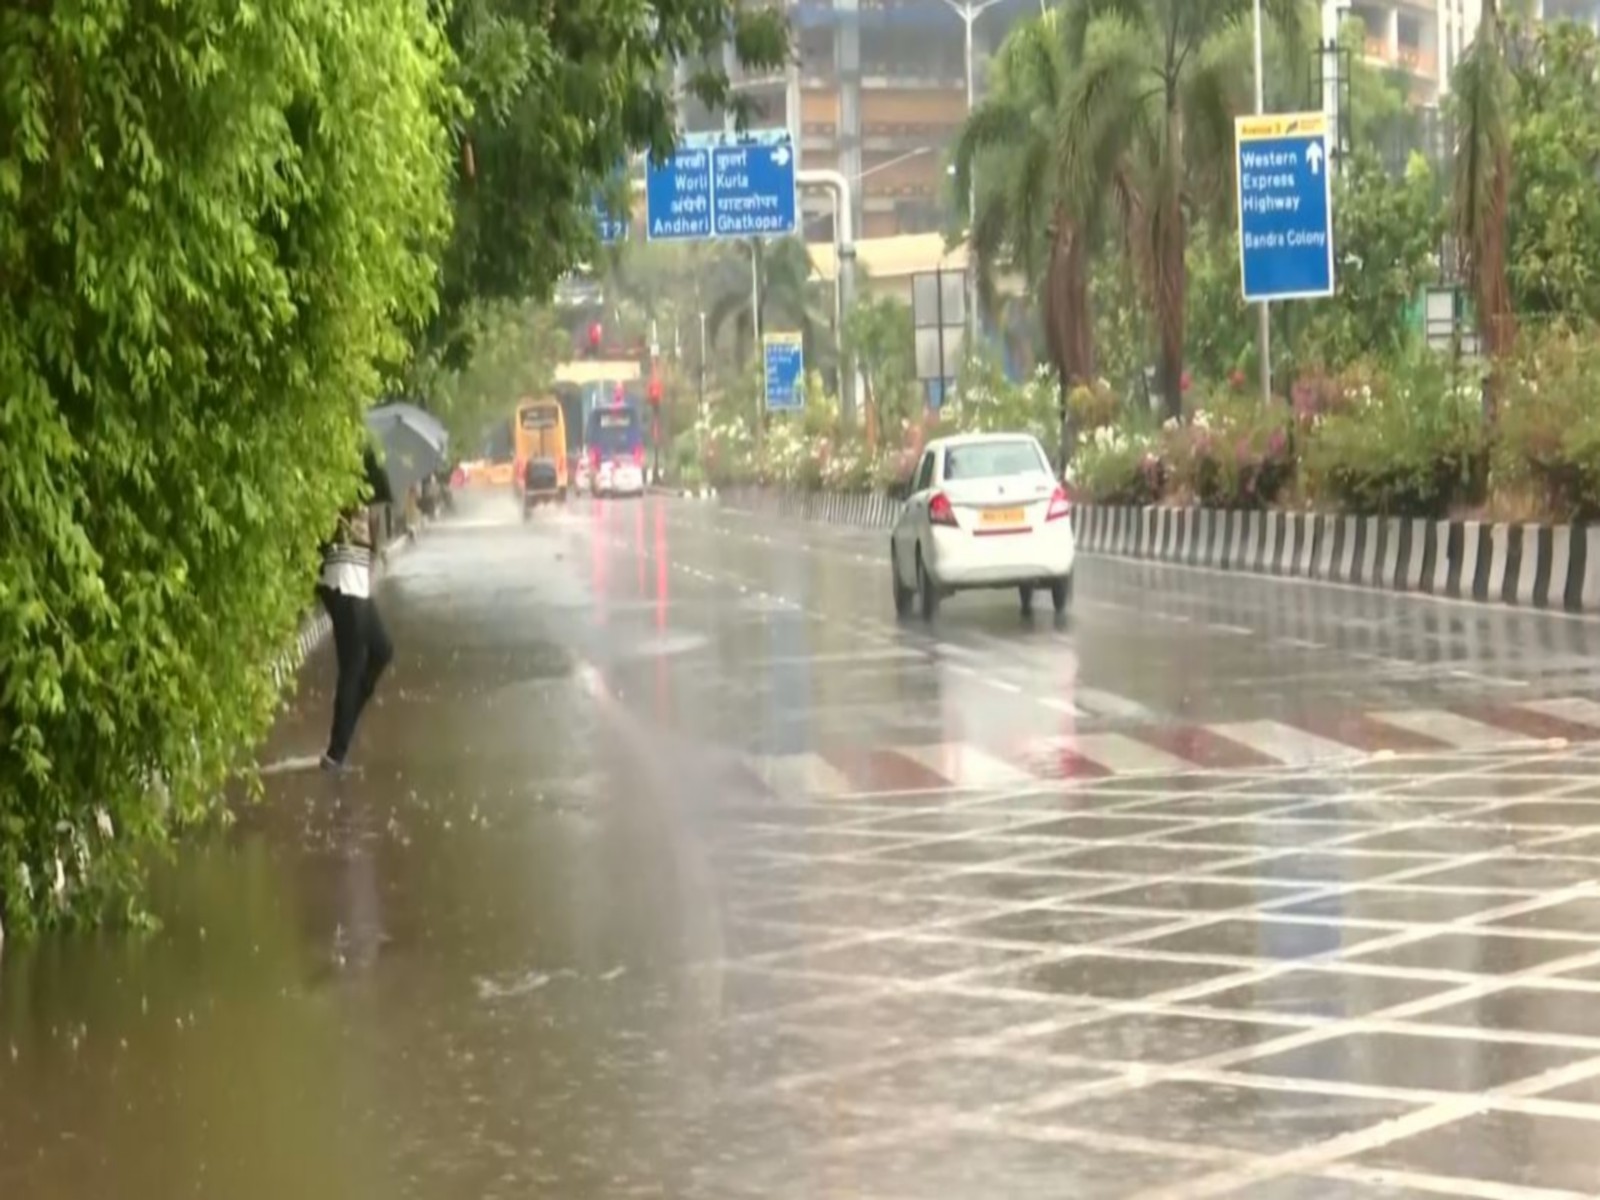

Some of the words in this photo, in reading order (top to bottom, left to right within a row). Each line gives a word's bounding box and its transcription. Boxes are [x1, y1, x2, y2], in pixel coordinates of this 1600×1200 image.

[1242, 152, 1297, 168] Western
[675, 174, 708, 191] Worli
[716, 173, 748, 189] Kurla
[1243, 173, 1294, 190] Express
[1244, 195, 1300, 213] Highway
[654, 217, 709, 234] Andheri
[717, 213, 783, 232] Ghatkopar
[1245, 231, 1284, 248] Bandra
[1287, 229, 1325, 247] Colony
